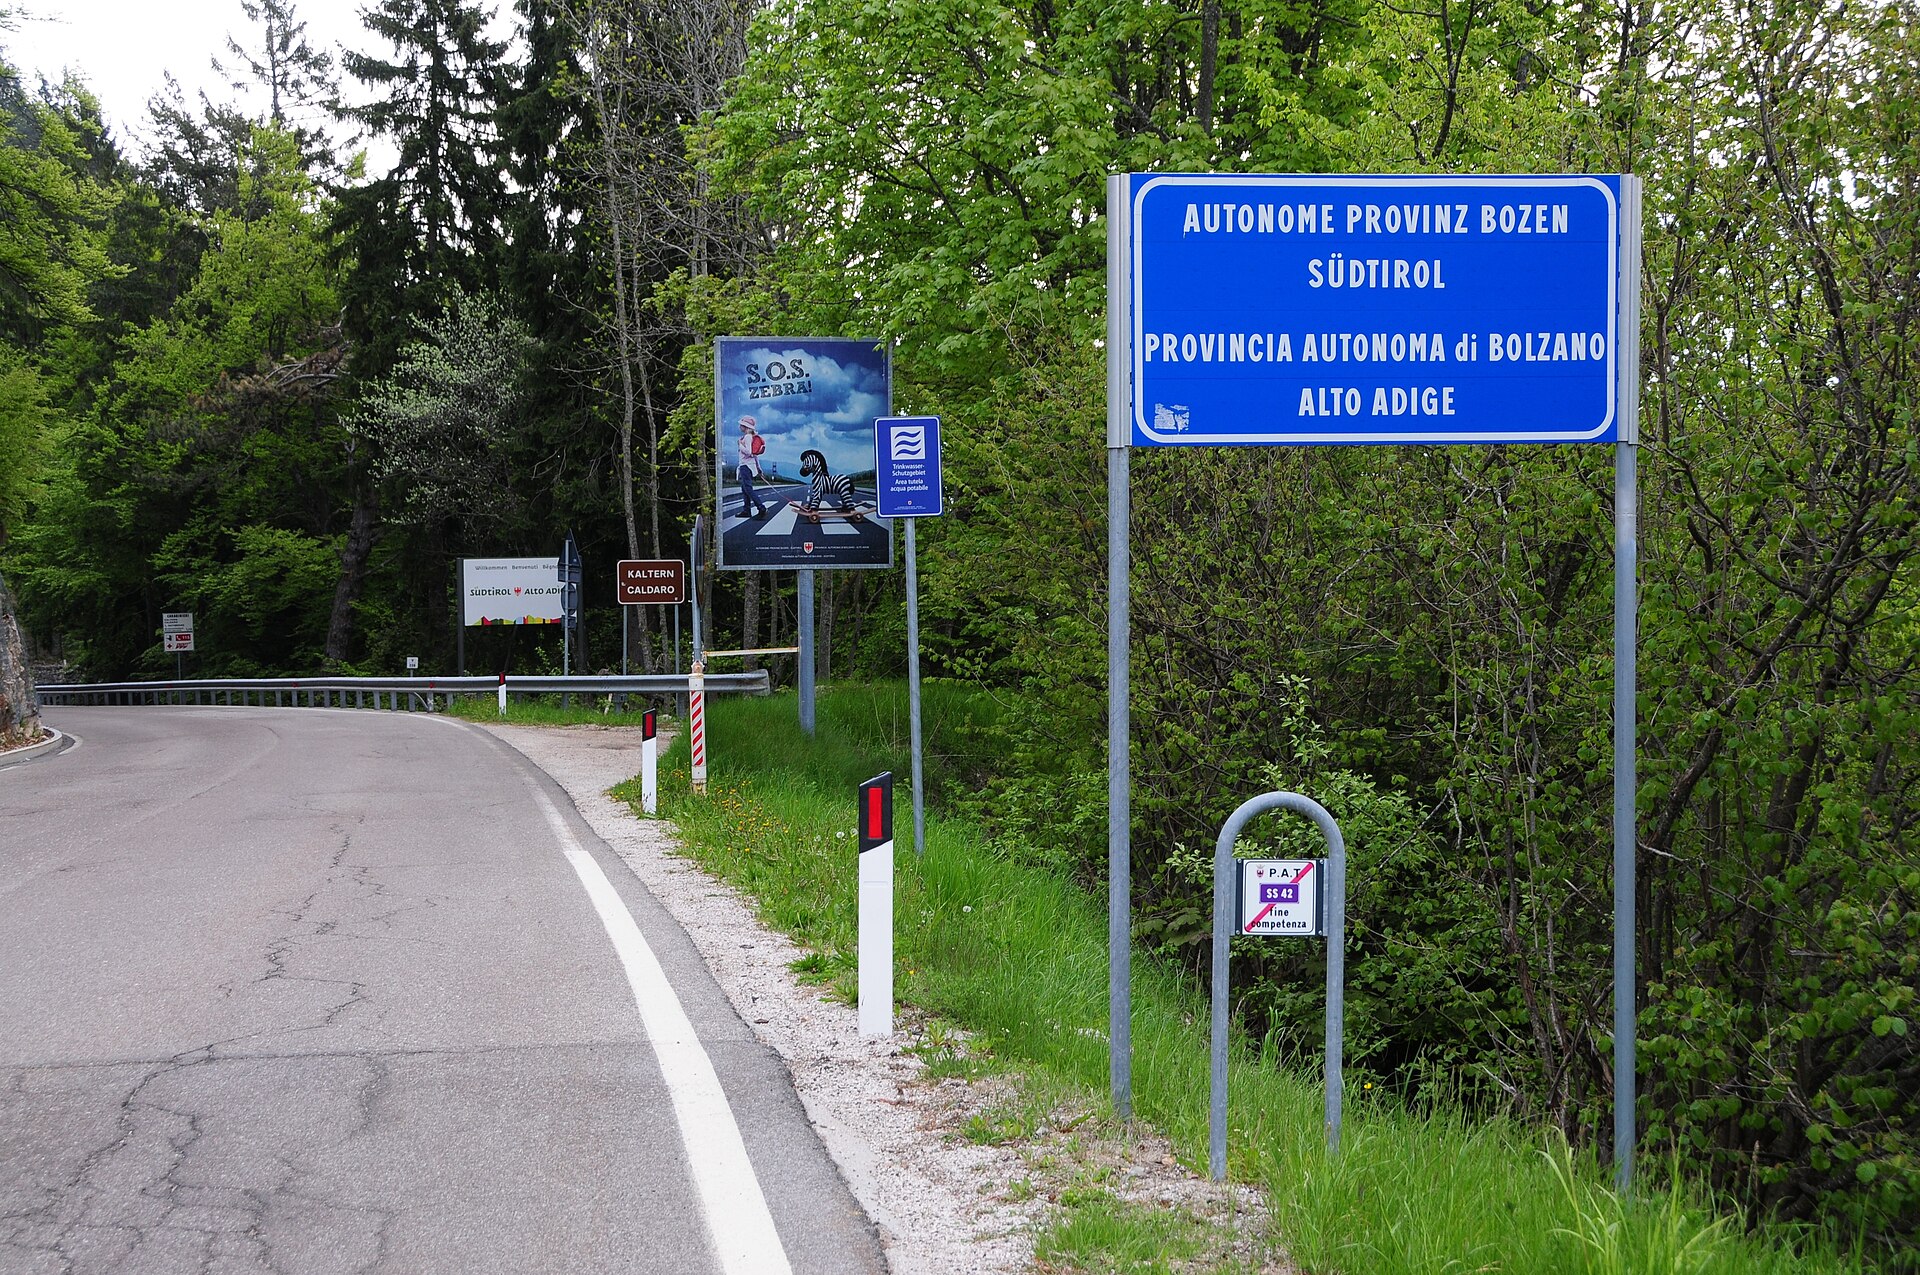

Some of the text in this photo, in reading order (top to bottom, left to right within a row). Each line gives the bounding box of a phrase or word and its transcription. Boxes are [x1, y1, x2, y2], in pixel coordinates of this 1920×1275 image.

[1183, 204, 1569, 235] AUTONOME PROVINZ BOZEN
[1307, 252, 1446, 289] SÜDTIROL
[1144, 332, 1606, 363] PROVINCIA AUTONOMA di BOLZANO
[746, 358, 810, 384] S.O.S.
[748, 380, 812, 400] ZEBRA!
[1298, 386, 1456, 417] ALTO ADIGE
[891, 469, 926, 477] Schutzgebiet
[906, 484, 929, 492] potabile
[627, 569, 675, 579] KALTERN
[627, 585, 675, 595] CALDARO
[1269, 868, 1304, 878] P.A.T.
[1266, 888, 1293, 898] SS 42
[1269, 906, 1289, 917] fine
[1251, 919, 1307, 931] competenza
